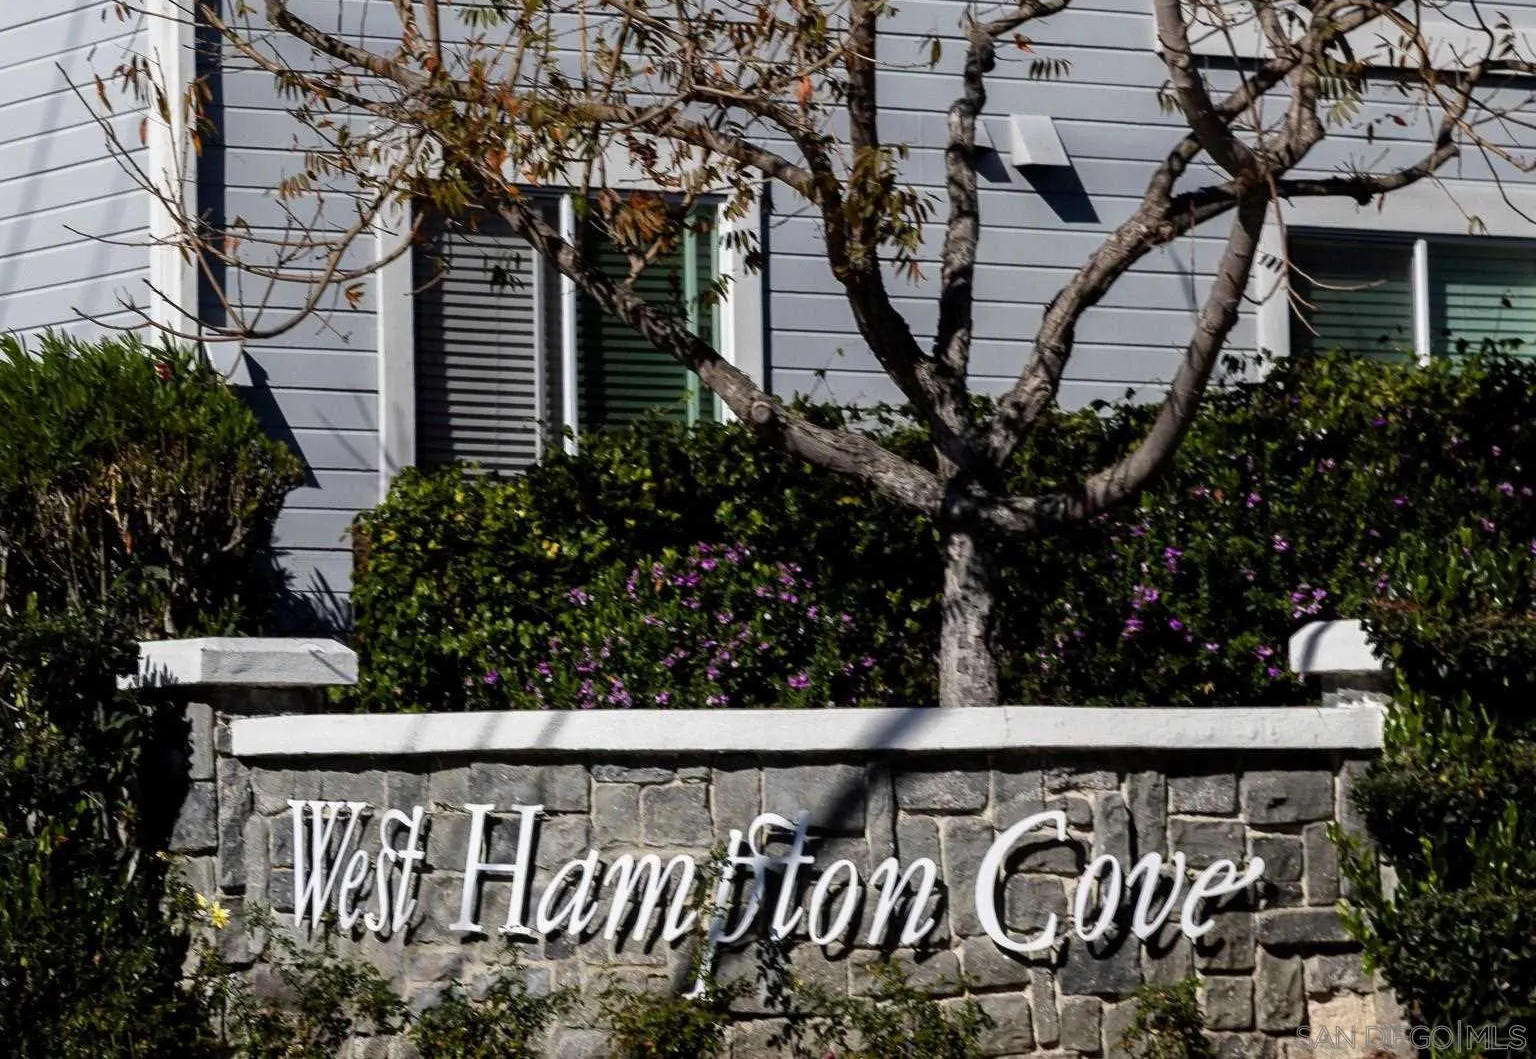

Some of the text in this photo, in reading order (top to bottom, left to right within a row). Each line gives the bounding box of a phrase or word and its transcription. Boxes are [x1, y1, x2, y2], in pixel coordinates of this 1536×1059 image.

[287, 799, 1266, 1000] West Hampton Cove
